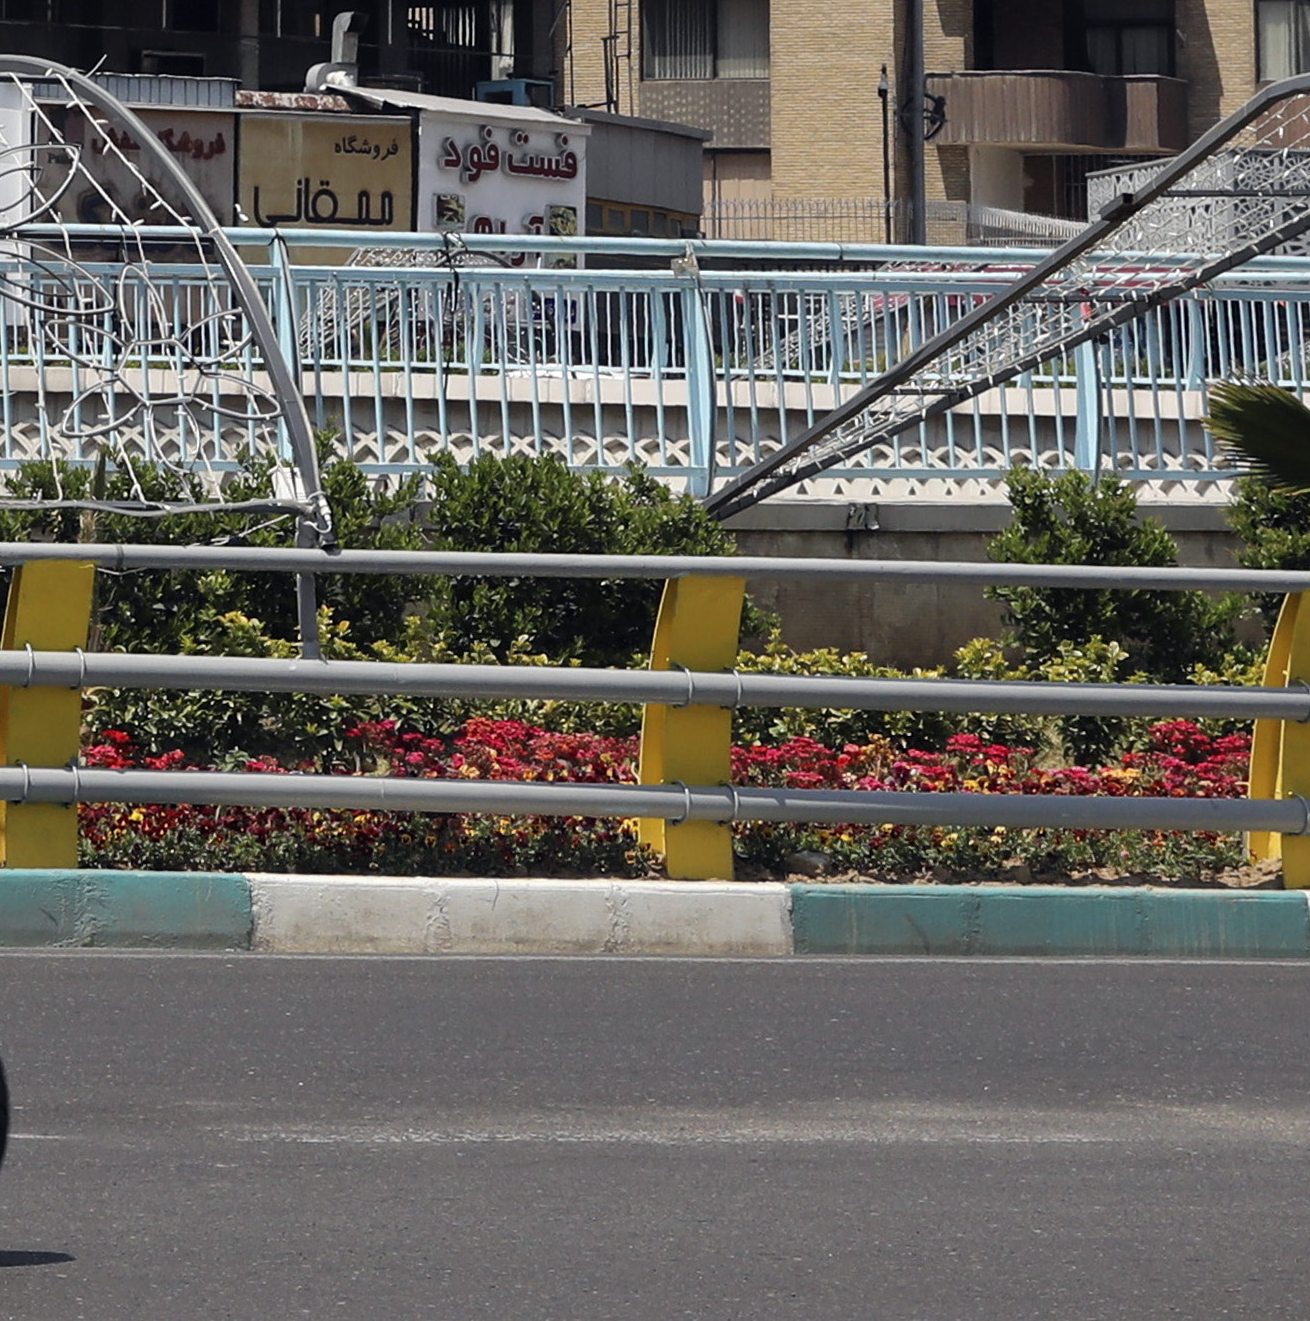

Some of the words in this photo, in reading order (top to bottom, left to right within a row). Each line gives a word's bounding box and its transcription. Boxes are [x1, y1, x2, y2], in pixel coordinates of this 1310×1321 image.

[334, 136, 399, 161] فروشگاه
[439, 125, 500, 183] فود
[502, 129, 579, 181] فست
